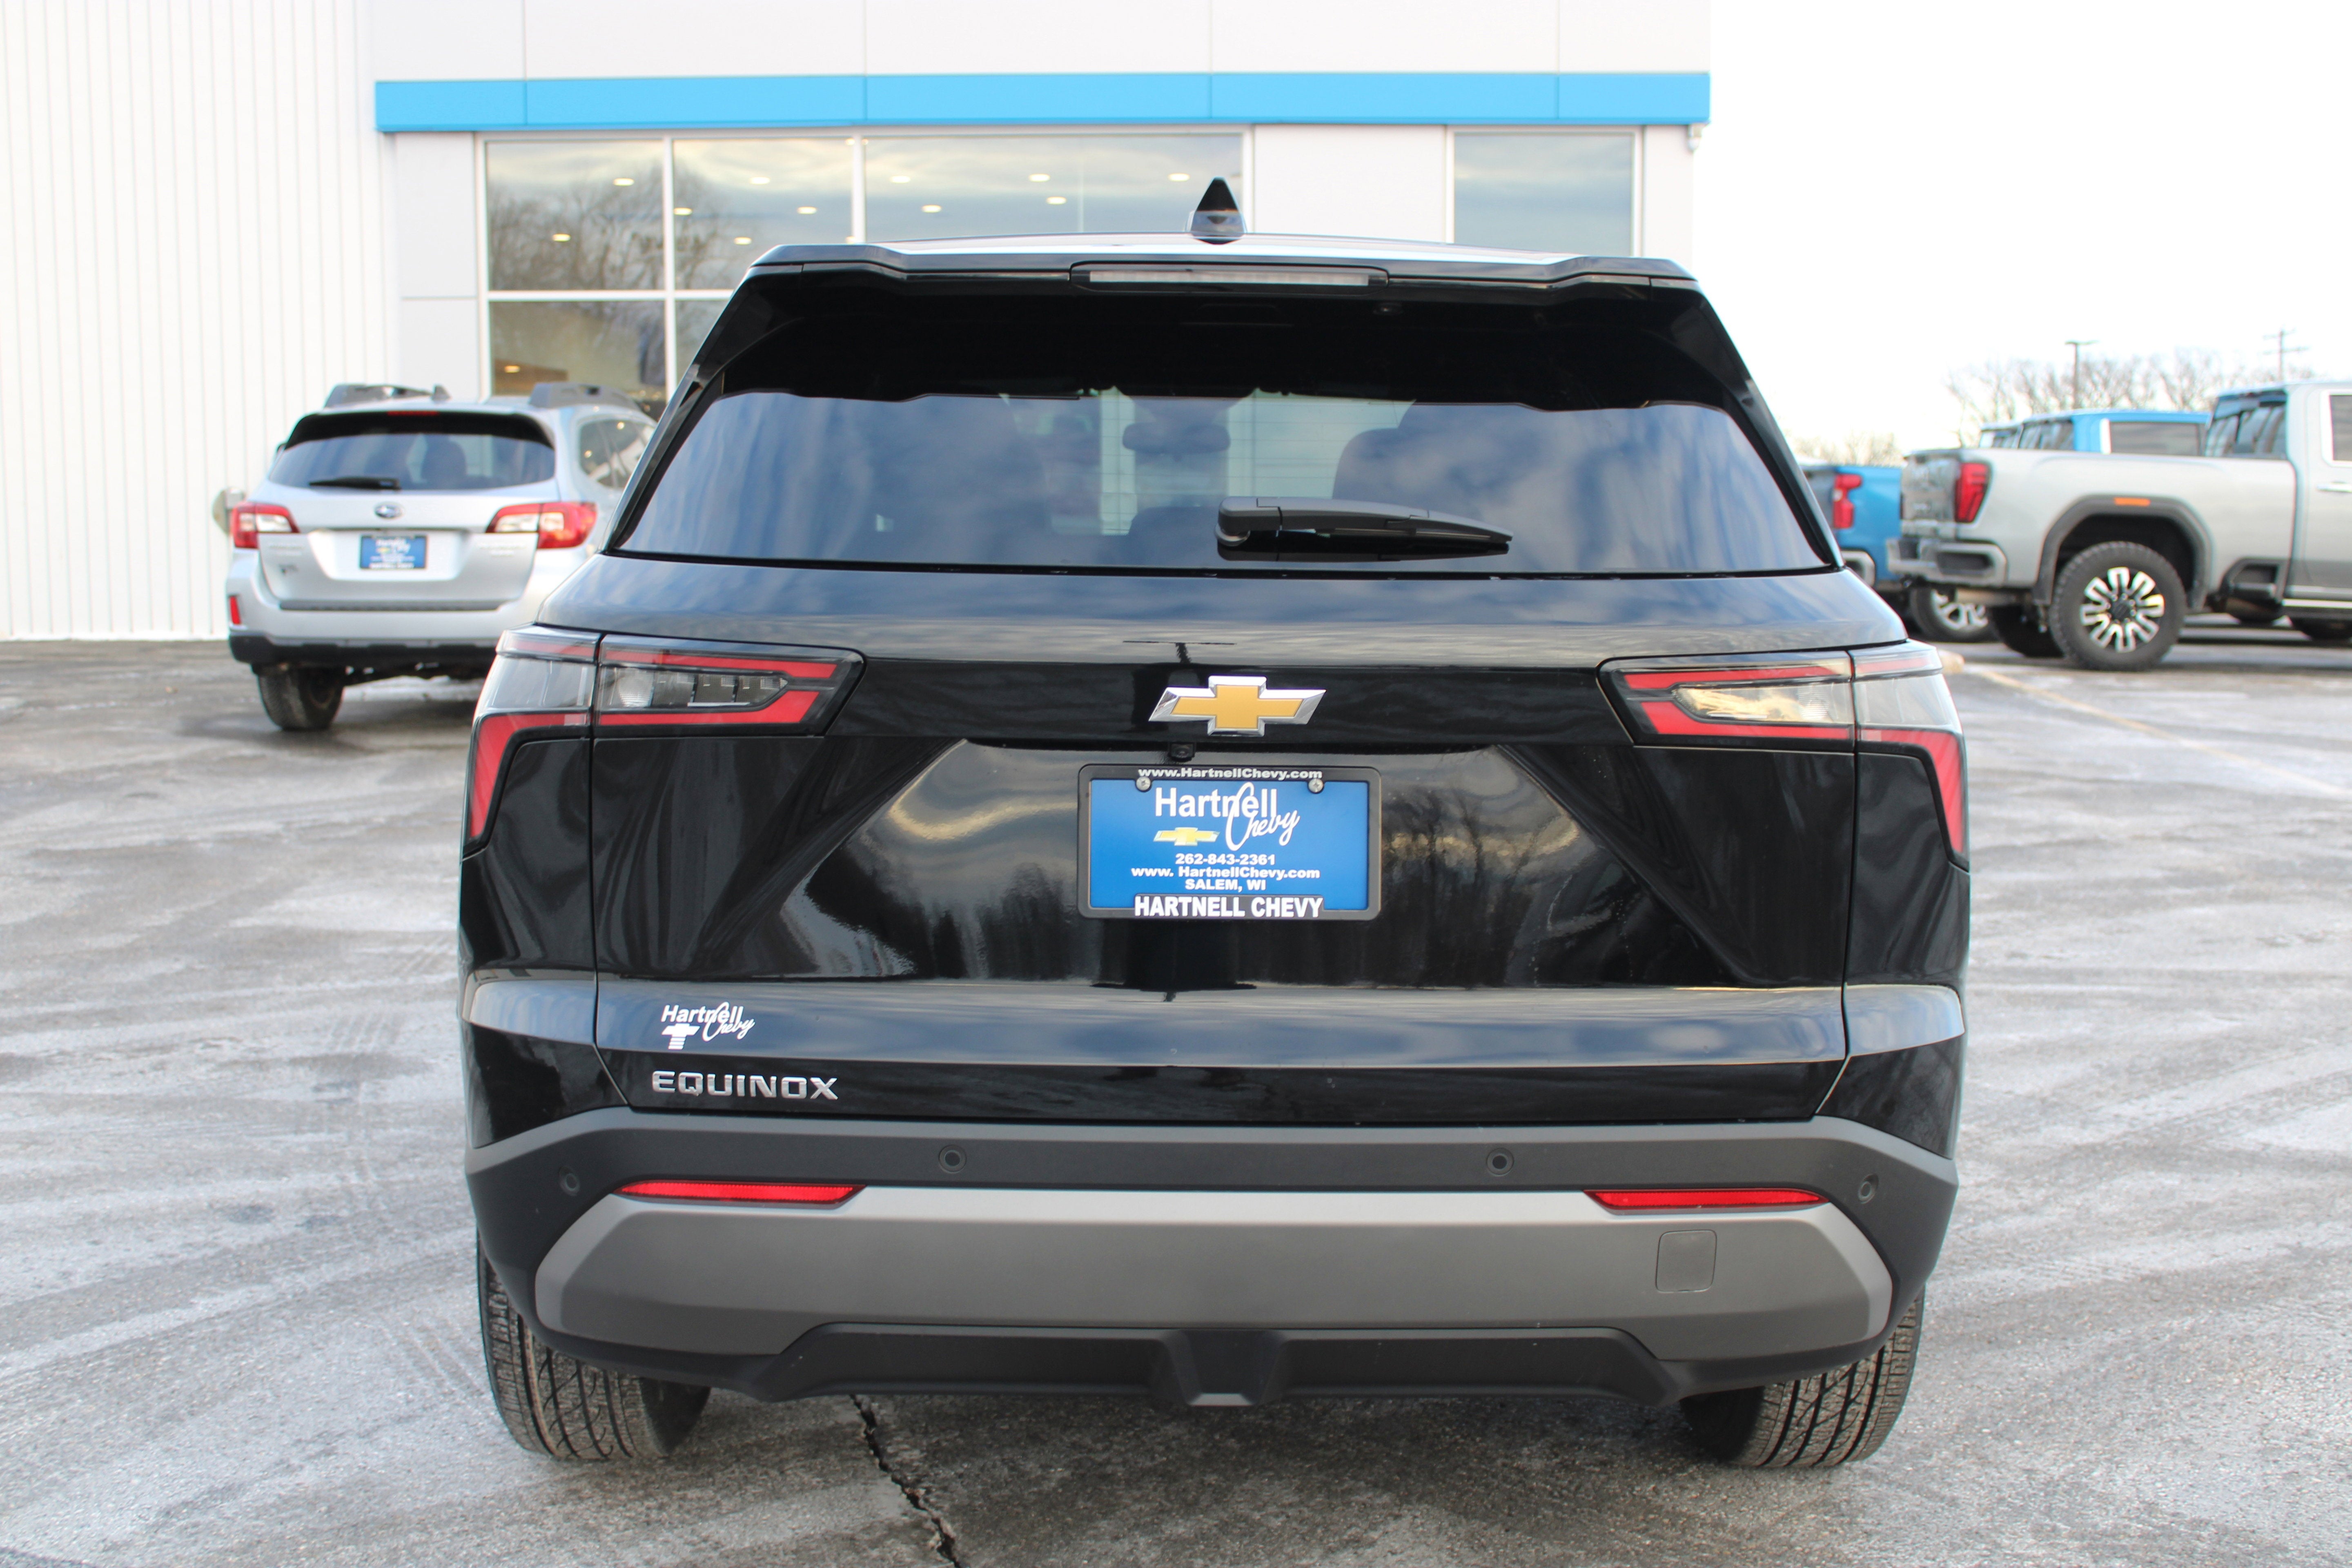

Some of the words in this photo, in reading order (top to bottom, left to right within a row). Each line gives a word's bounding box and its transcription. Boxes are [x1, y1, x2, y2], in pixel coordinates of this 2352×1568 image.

[1138, 768, 1323, 781] www.HartnellChevy.com
[1155, 787, 1277, 817] Hartnell
[1225, 782, 1300, 851] Chevy
[1175, 853, 1276, 865] 262-843-2361
[1185, 879, 1243, 893] SALEM,
[1247, 880, 1266, 890] WI
[1134, 896, 1245, 918] HARTNELL
[1251, 898, 1323, 918] CHEVY
[661, 1004, 744, 1024] Hartnell
[702, 1001, 755, 1042] Chevy
[653, 1070, 839, 1100] EQUINOX
